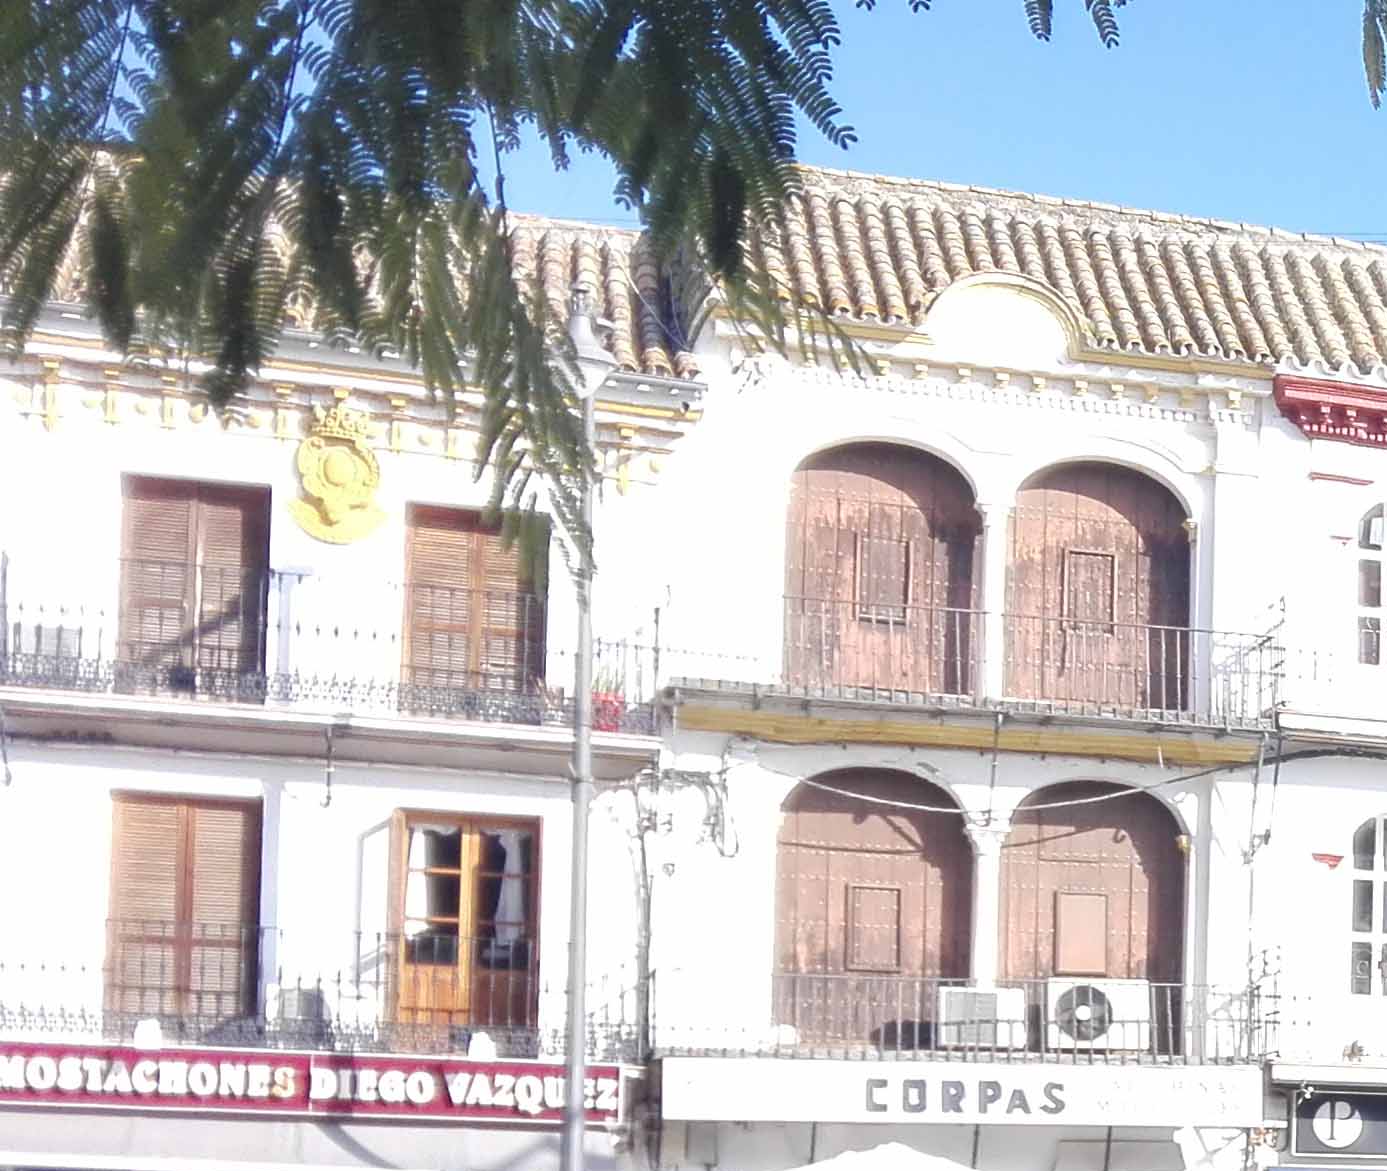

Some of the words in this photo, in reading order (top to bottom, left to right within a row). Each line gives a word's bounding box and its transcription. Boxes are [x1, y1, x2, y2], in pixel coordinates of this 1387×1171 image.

[0, 1053, 297, 1099] MOSTACHONES
[309, 1066, 436, 1105] DIEGO
[865, 1078, 1067, 1115] CORPAS
